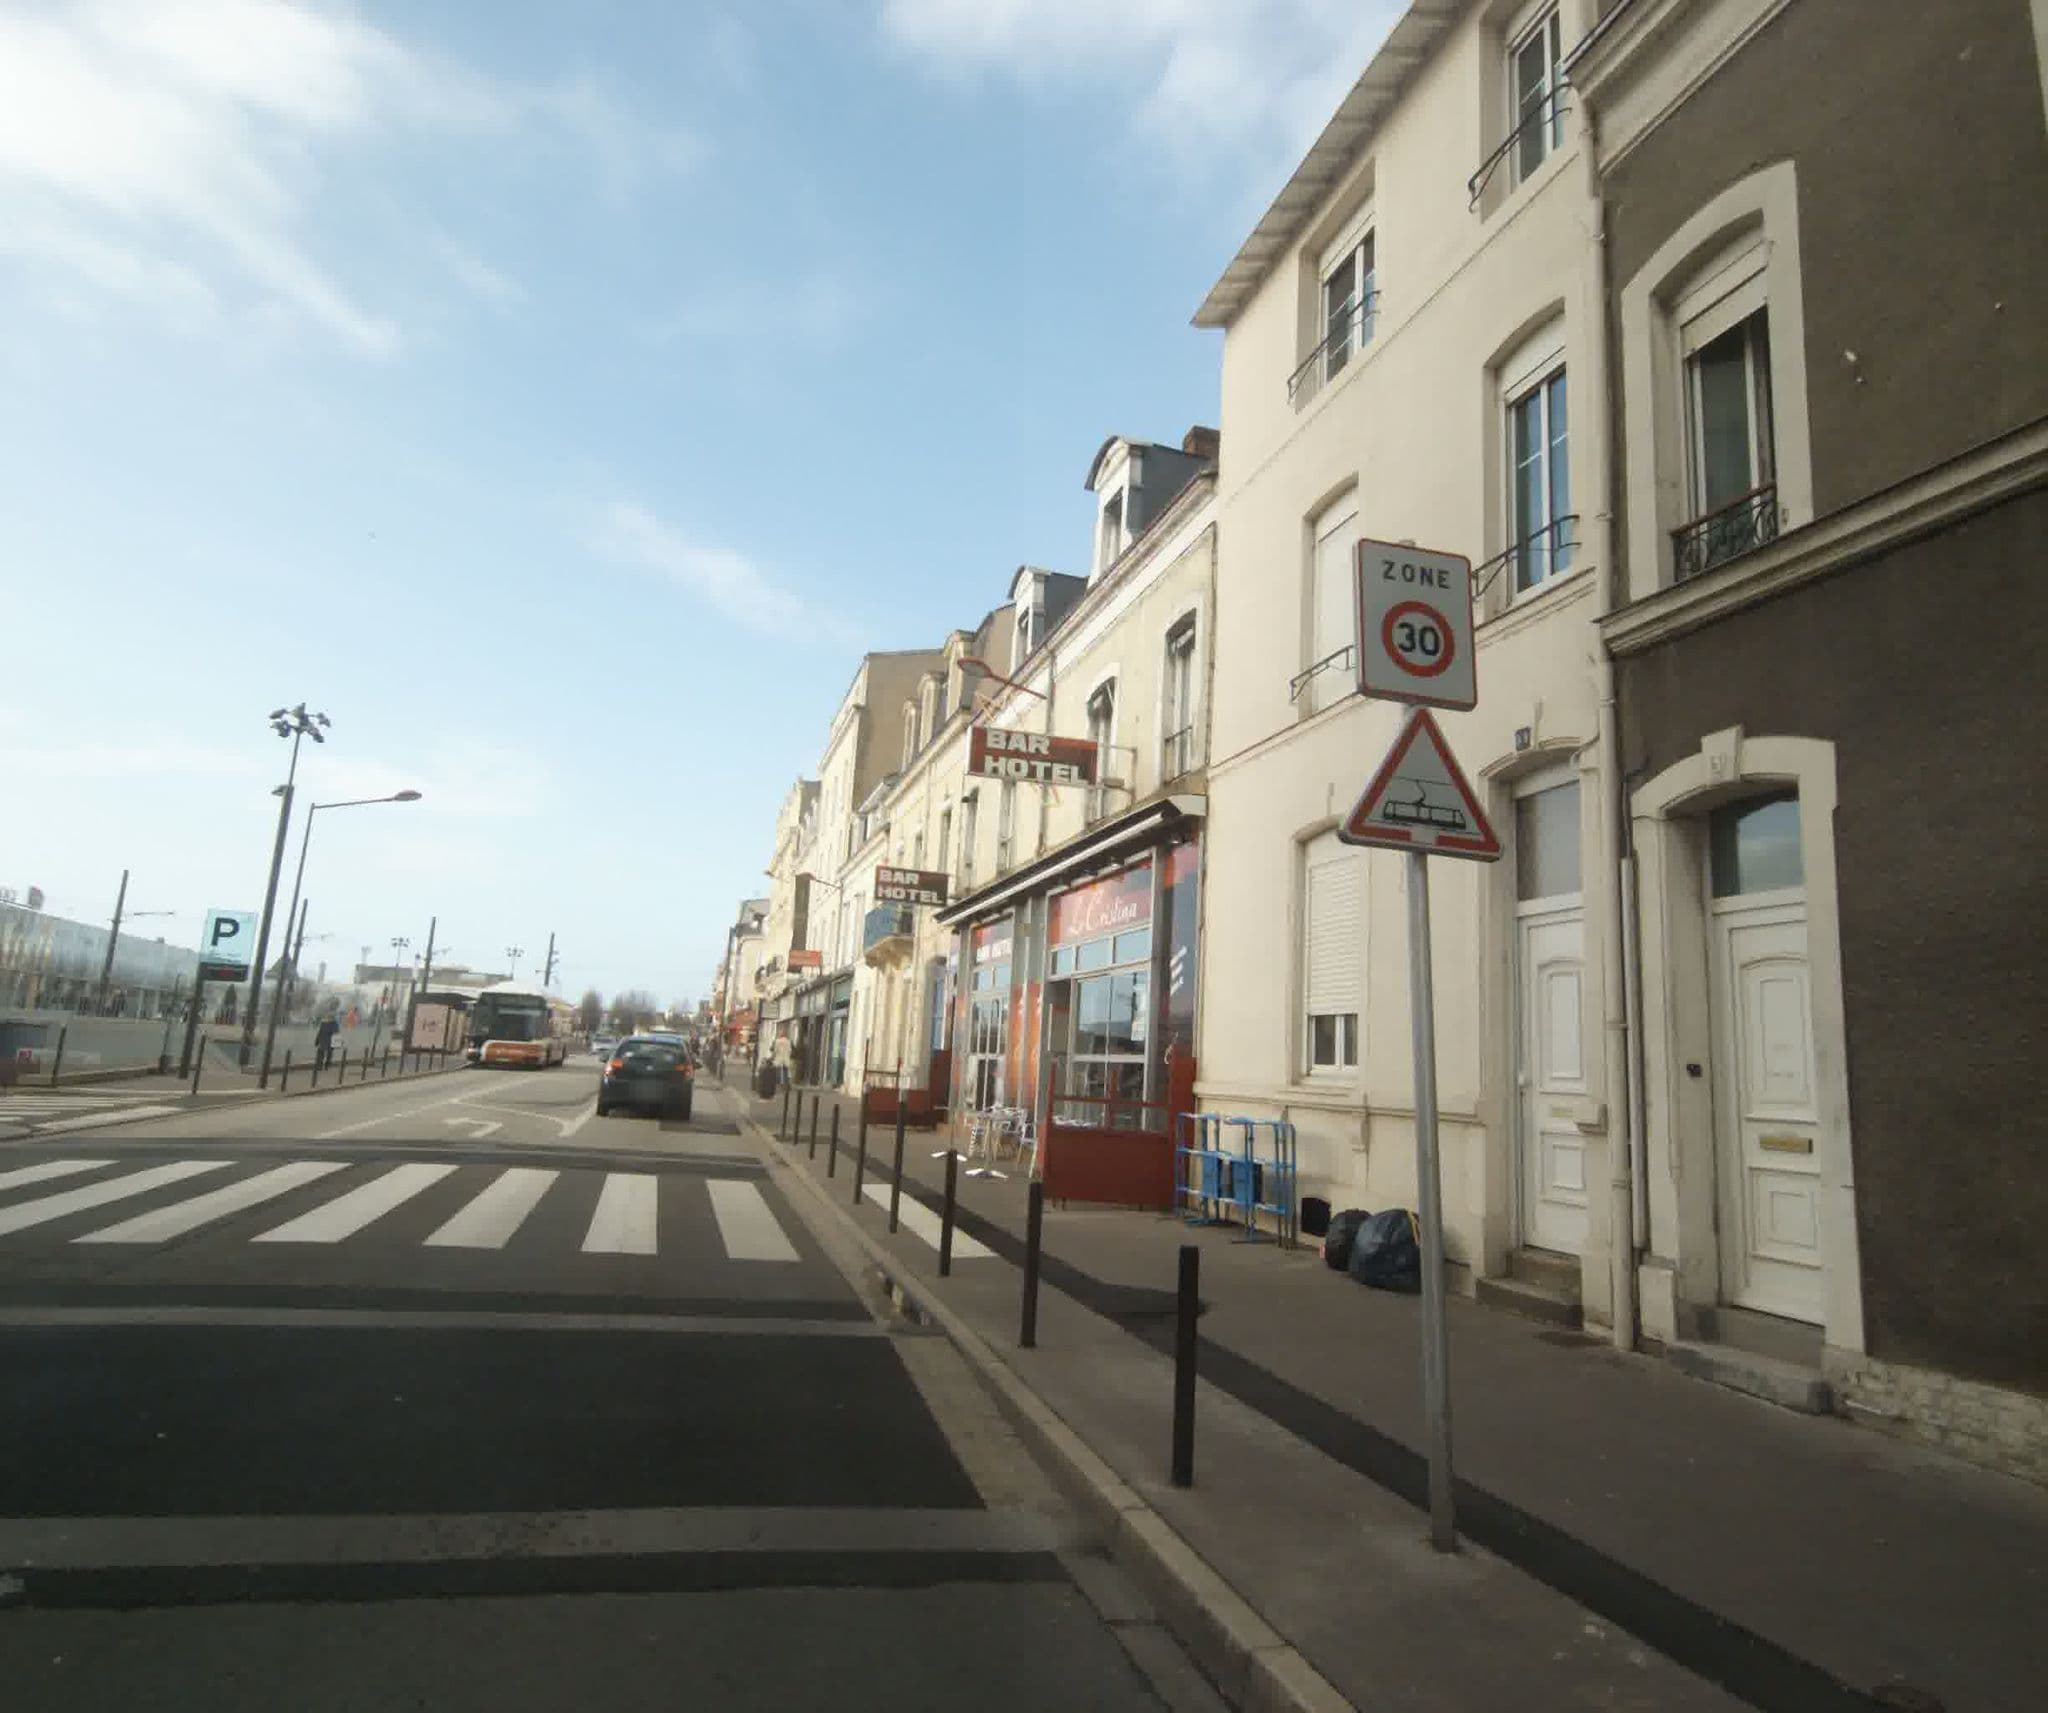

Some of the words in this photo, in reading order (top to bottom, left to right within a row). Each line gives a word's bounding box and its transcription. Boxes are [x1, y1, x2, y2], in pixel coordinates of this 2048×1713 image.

[1382, 560, 1450, 589] ZONE
[1397, 621, 1441, 657] 30
[986, 728, 1050, 755] BAR
[984, 755, 1088, 782] HOTEL
[879, 869, 919, 885] BAR
[877, 885, 945, 903] HOTEL
[211, 917, 240, 946] P
